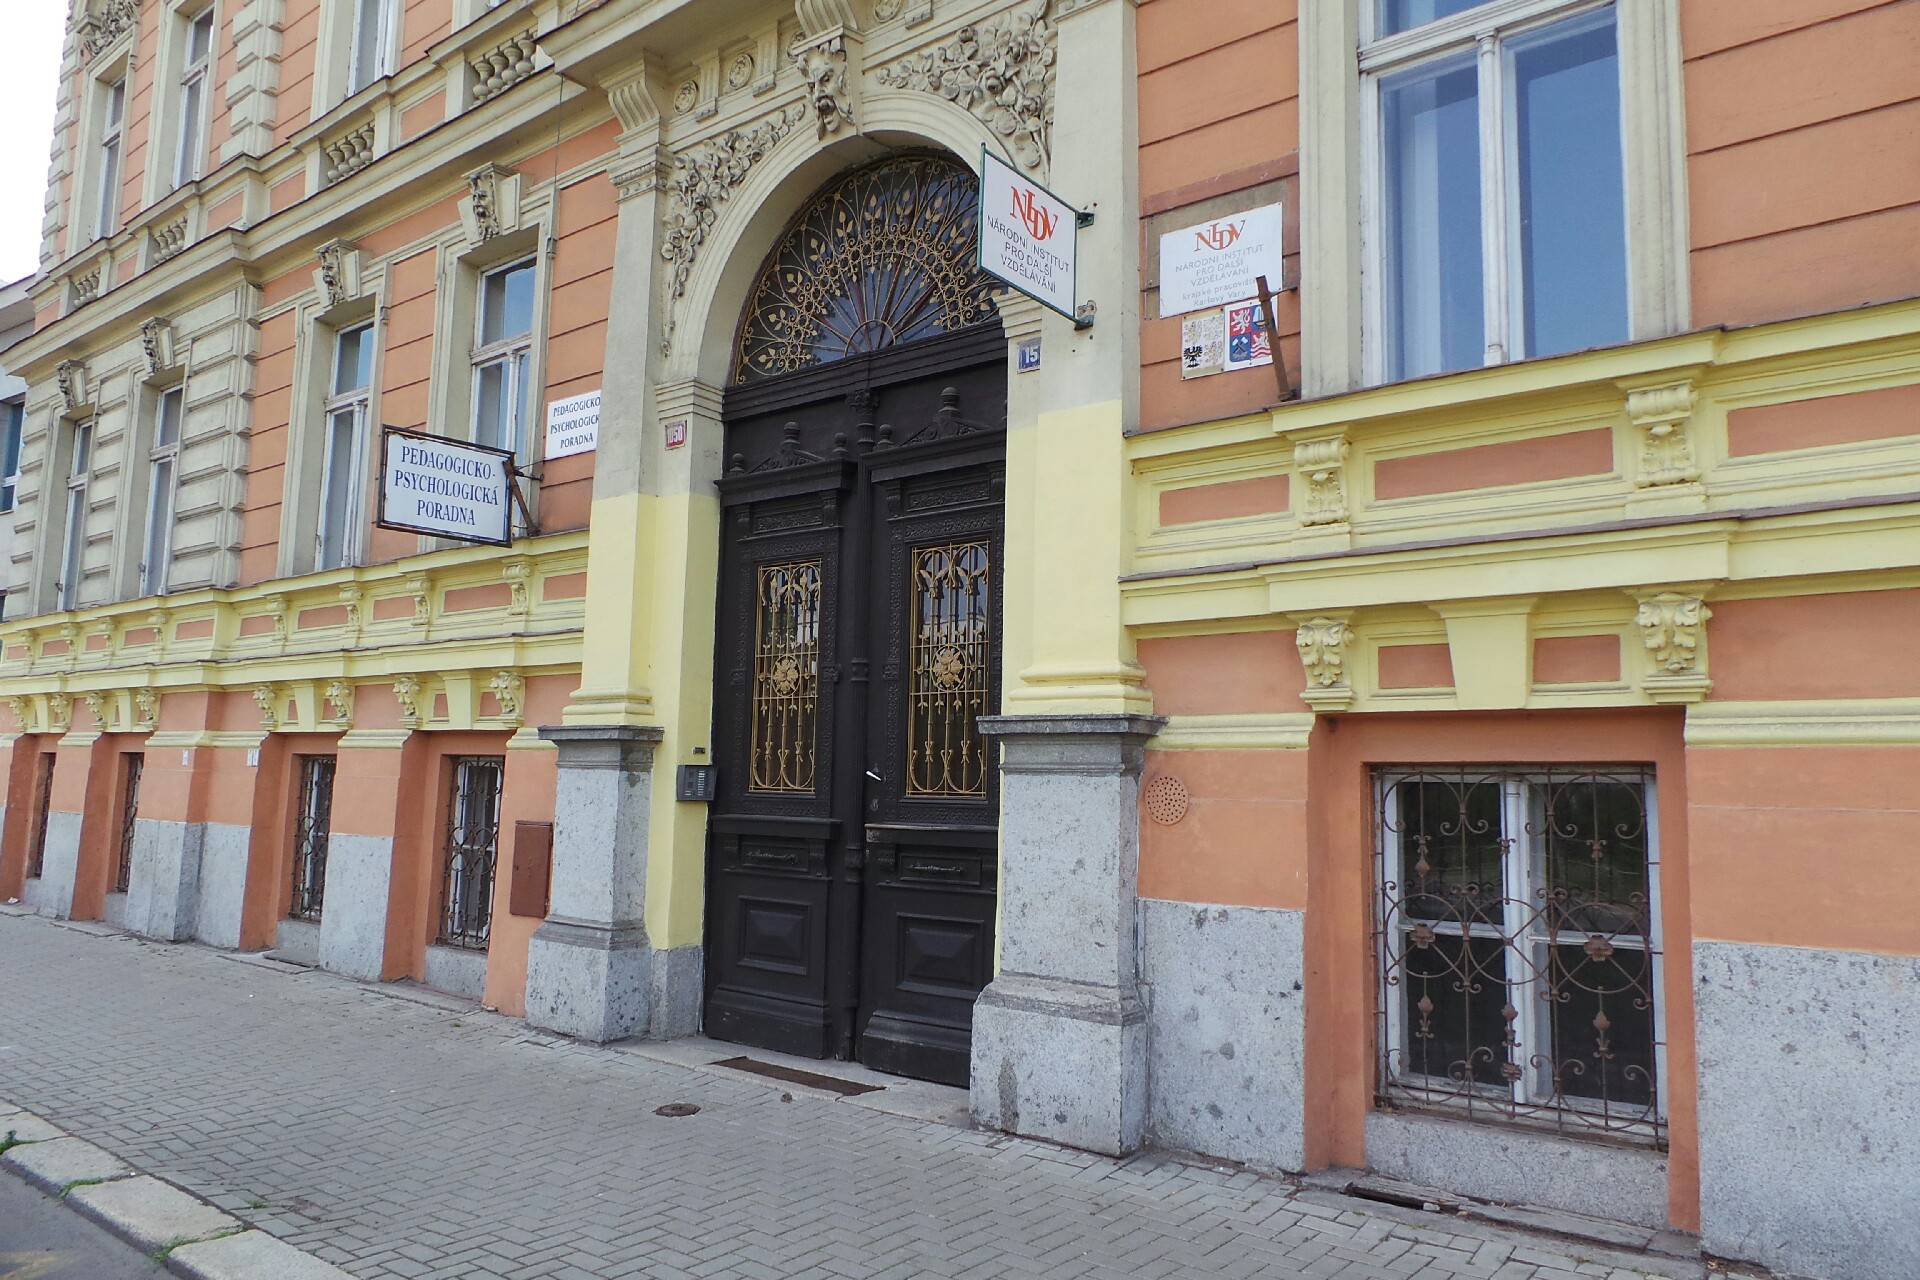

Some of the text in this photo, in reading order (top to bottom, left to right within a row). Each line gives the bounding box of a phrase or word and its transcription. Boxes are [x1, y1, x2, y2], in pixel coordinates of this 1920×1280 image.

[987, 215, 1069, 273] NÁRODNÍ INSTITUT
[1222, 244, 1264, 260] INSTITUT
[1005, 241, 1052, 278] PRO DALŠÍ
[1000, 253, 1056, 294] VZDĚLÁVÁNÍ
[1196, 265, 1215, 277] PRO
[1025, 346, 1039, 364] 15
[553, 396, 601, 418] PEDAGOGICKO
[550, 414, 600, 435] PSYCHOLOGICK
[560, 432, 594, 449] PORADNA
[394, 469, 499, 506] PSYCHOLOGICKÁ
[416, 499, 476, 526] PORADNA
